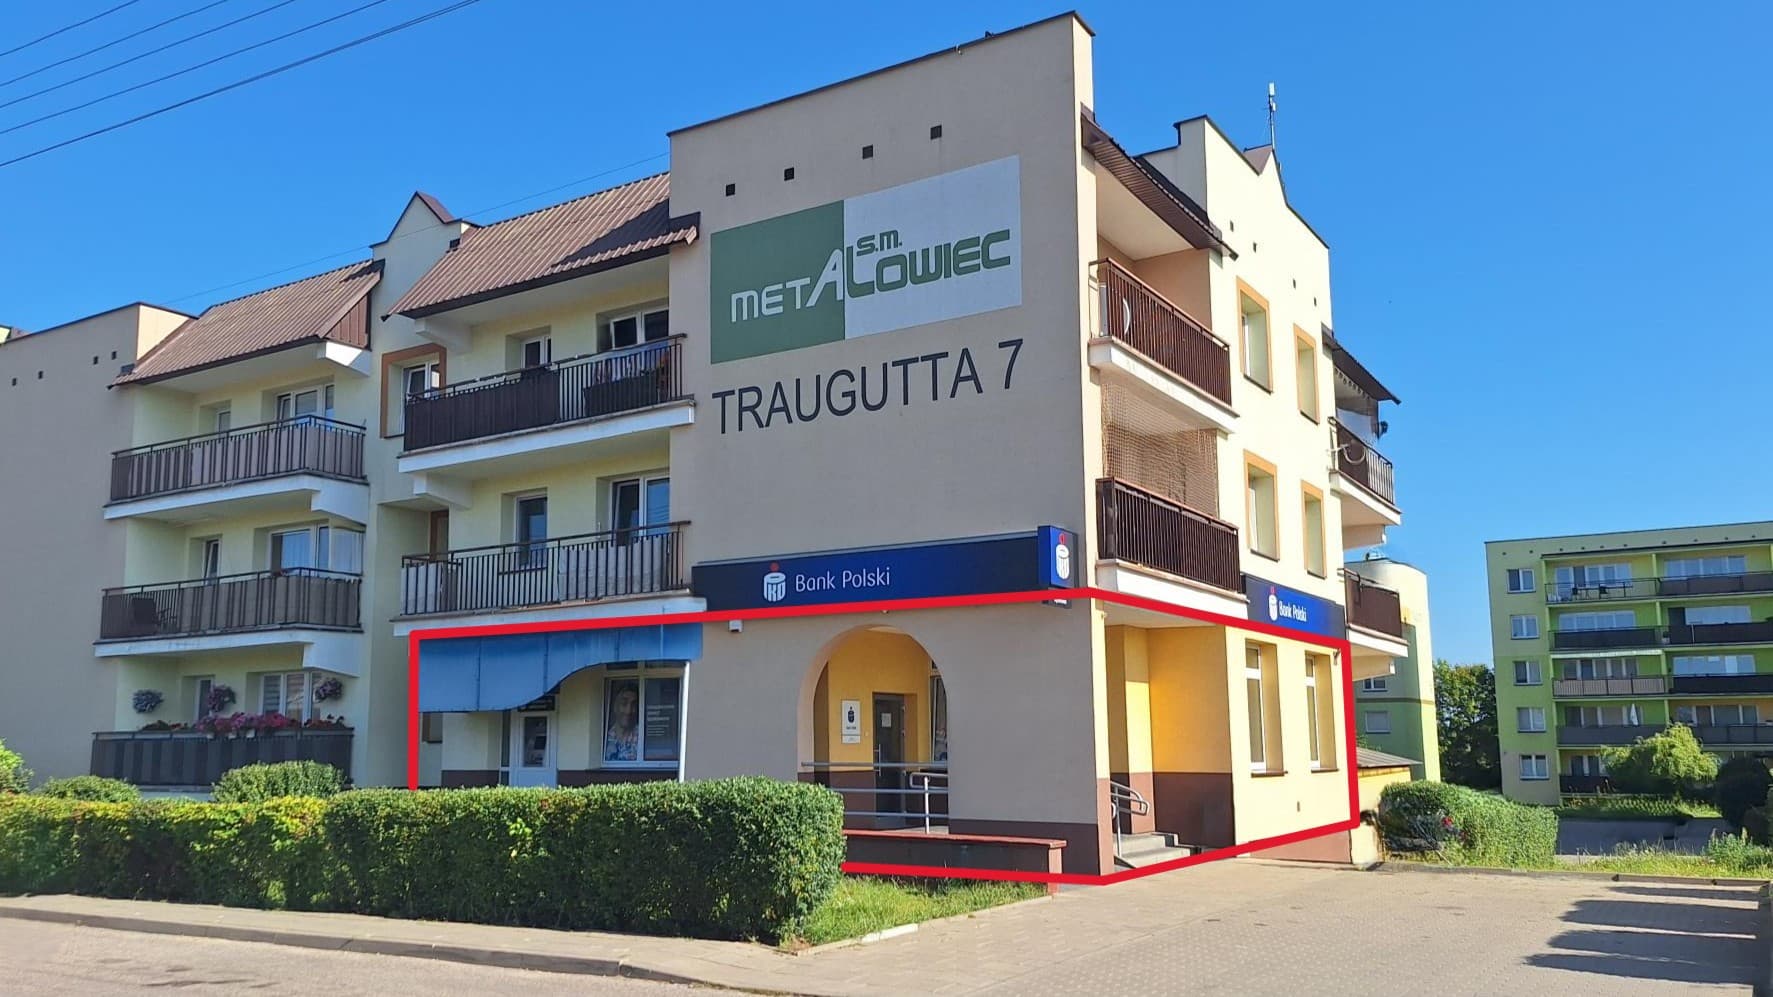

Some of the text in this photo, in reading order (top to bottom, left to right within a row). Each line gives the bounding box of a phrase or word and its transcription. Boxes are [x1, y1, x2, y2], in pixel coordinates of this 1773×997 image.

[712, 338, 1023, 434] TRAUGUTTA 7
[795, 566, 890, 592] Bank Polski
[1279, 600, 1292, 618] Bank
